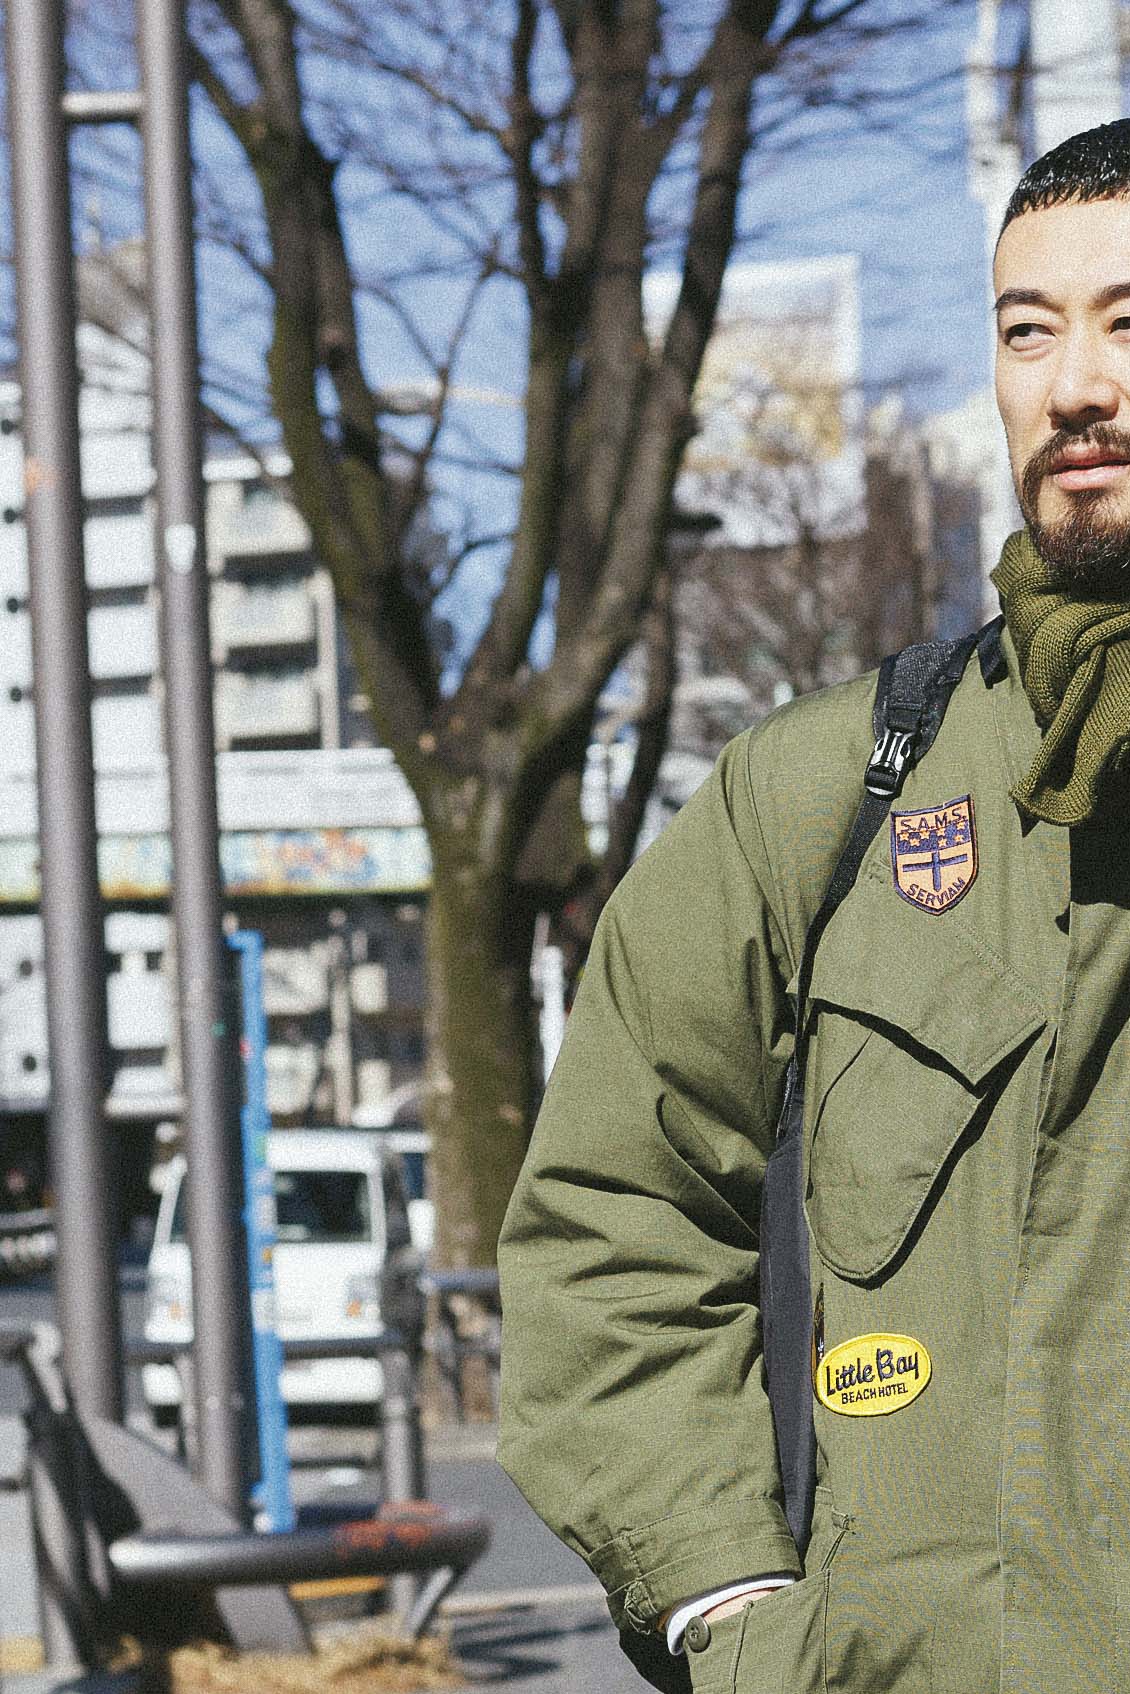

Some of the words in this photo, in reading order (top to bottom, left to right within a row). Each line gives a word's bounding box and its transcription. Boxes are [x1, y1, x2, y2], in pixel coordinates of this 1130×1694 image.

[906, 877, 966, 905] SERVIAM
[826, 1358, 875, 1397] Little
[876, 1348, 919, 1382] Bay
[841, 1388, 877, 1405] BEACH
[878, 1382, 909, 1398] HOTEL
